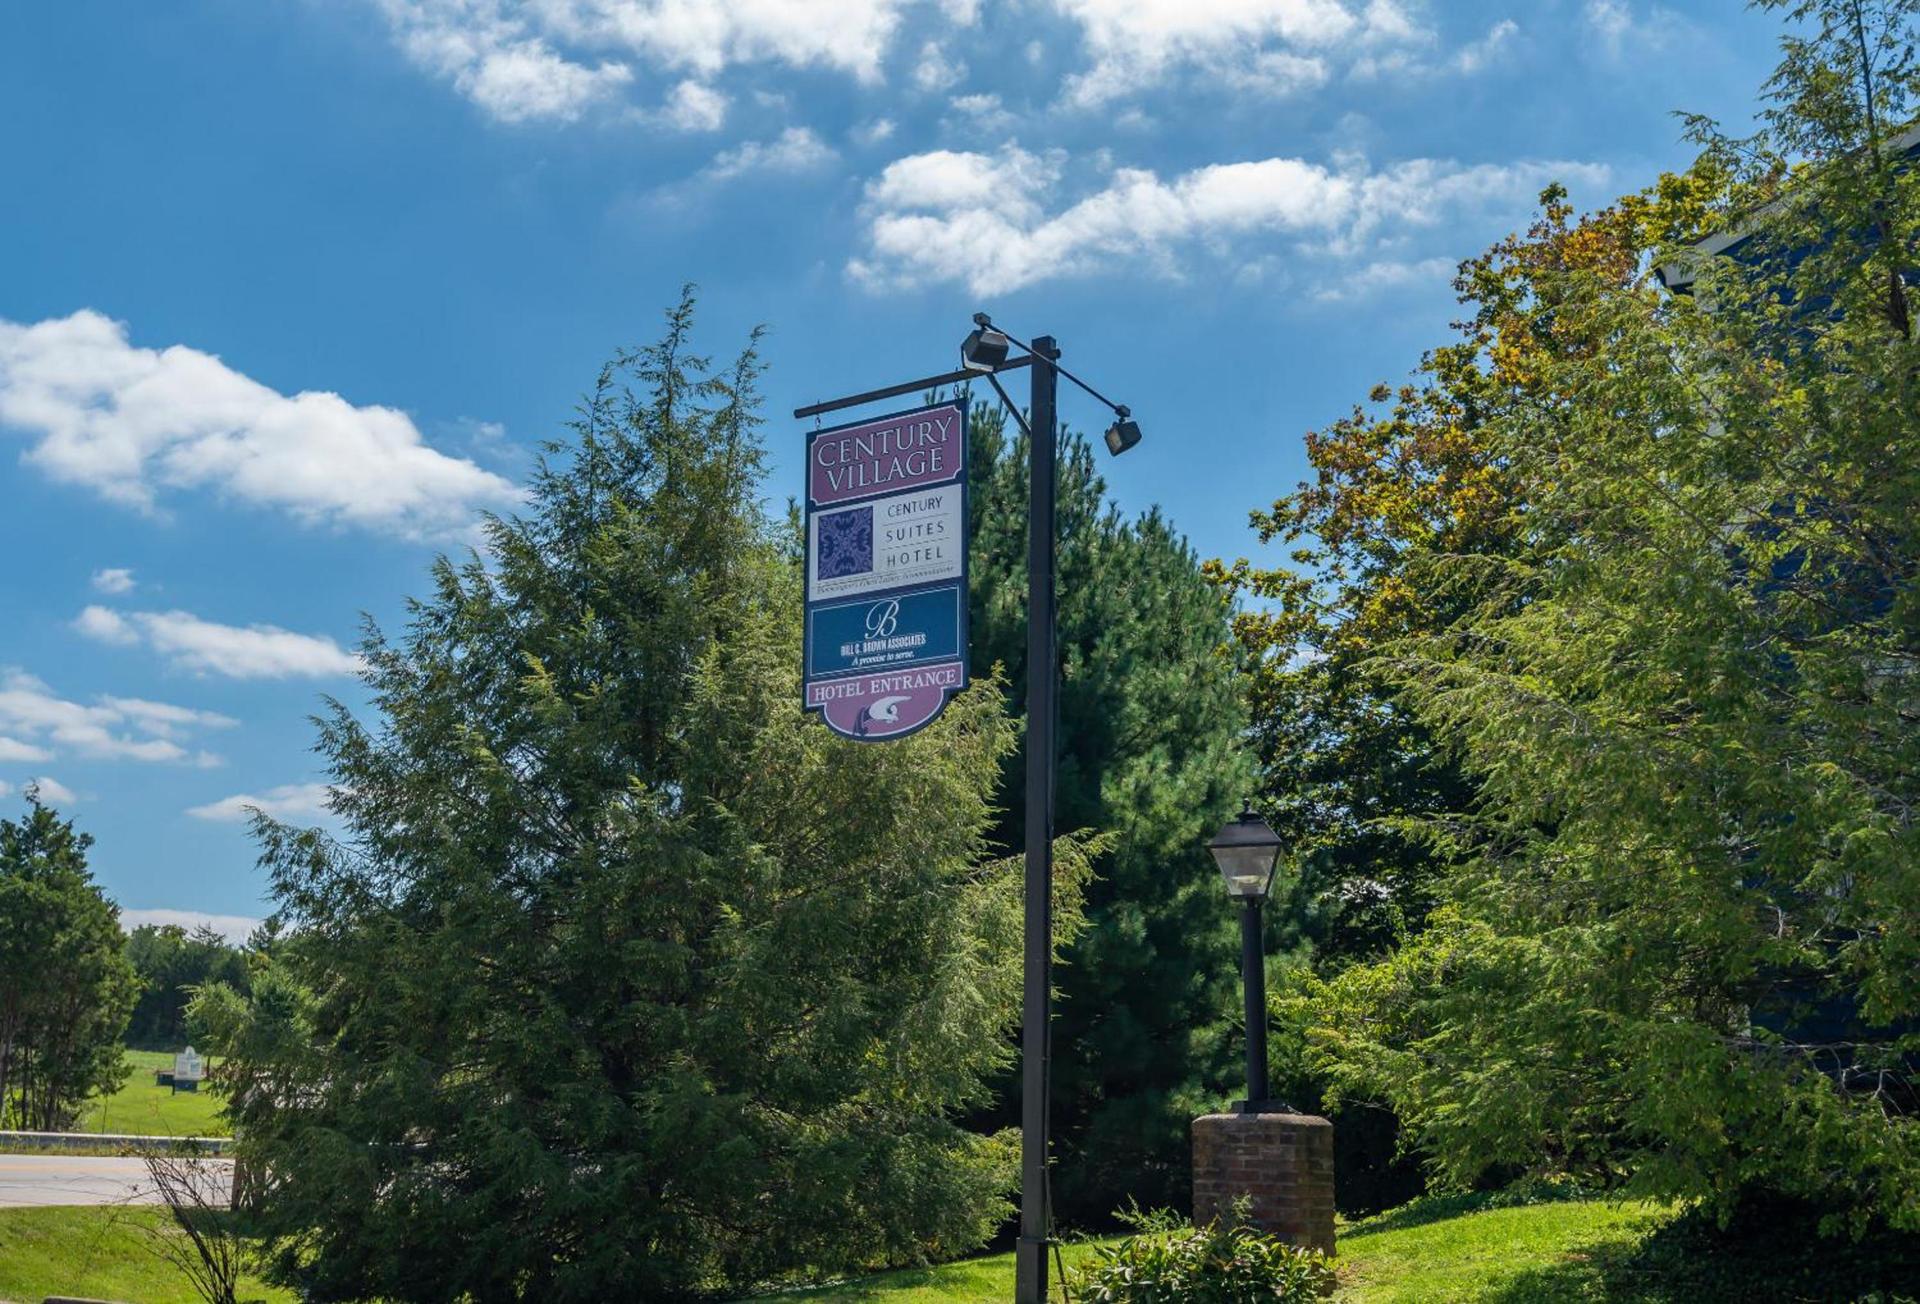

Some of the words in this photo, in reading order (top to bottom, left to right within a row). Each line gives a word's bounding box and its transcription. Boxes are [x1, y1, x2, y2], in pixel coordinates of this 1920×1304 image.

[818, 416, 952, 467] CENTURY
[827, 447, 943, 491] VILLAGE
[887, 496, 943, 517] CENTURY
[886, 521, 944, 542] SUITES
[887, 547, 942, 567] HOTEL
[865, 597, 902, 639] B
[888, 633, 926, 649] ASSOCIATES
[887, 652, 894, 661] to
[815, 682, 865, 702] HOTEL
[871, 669, 956, 694] ENTRANCE
